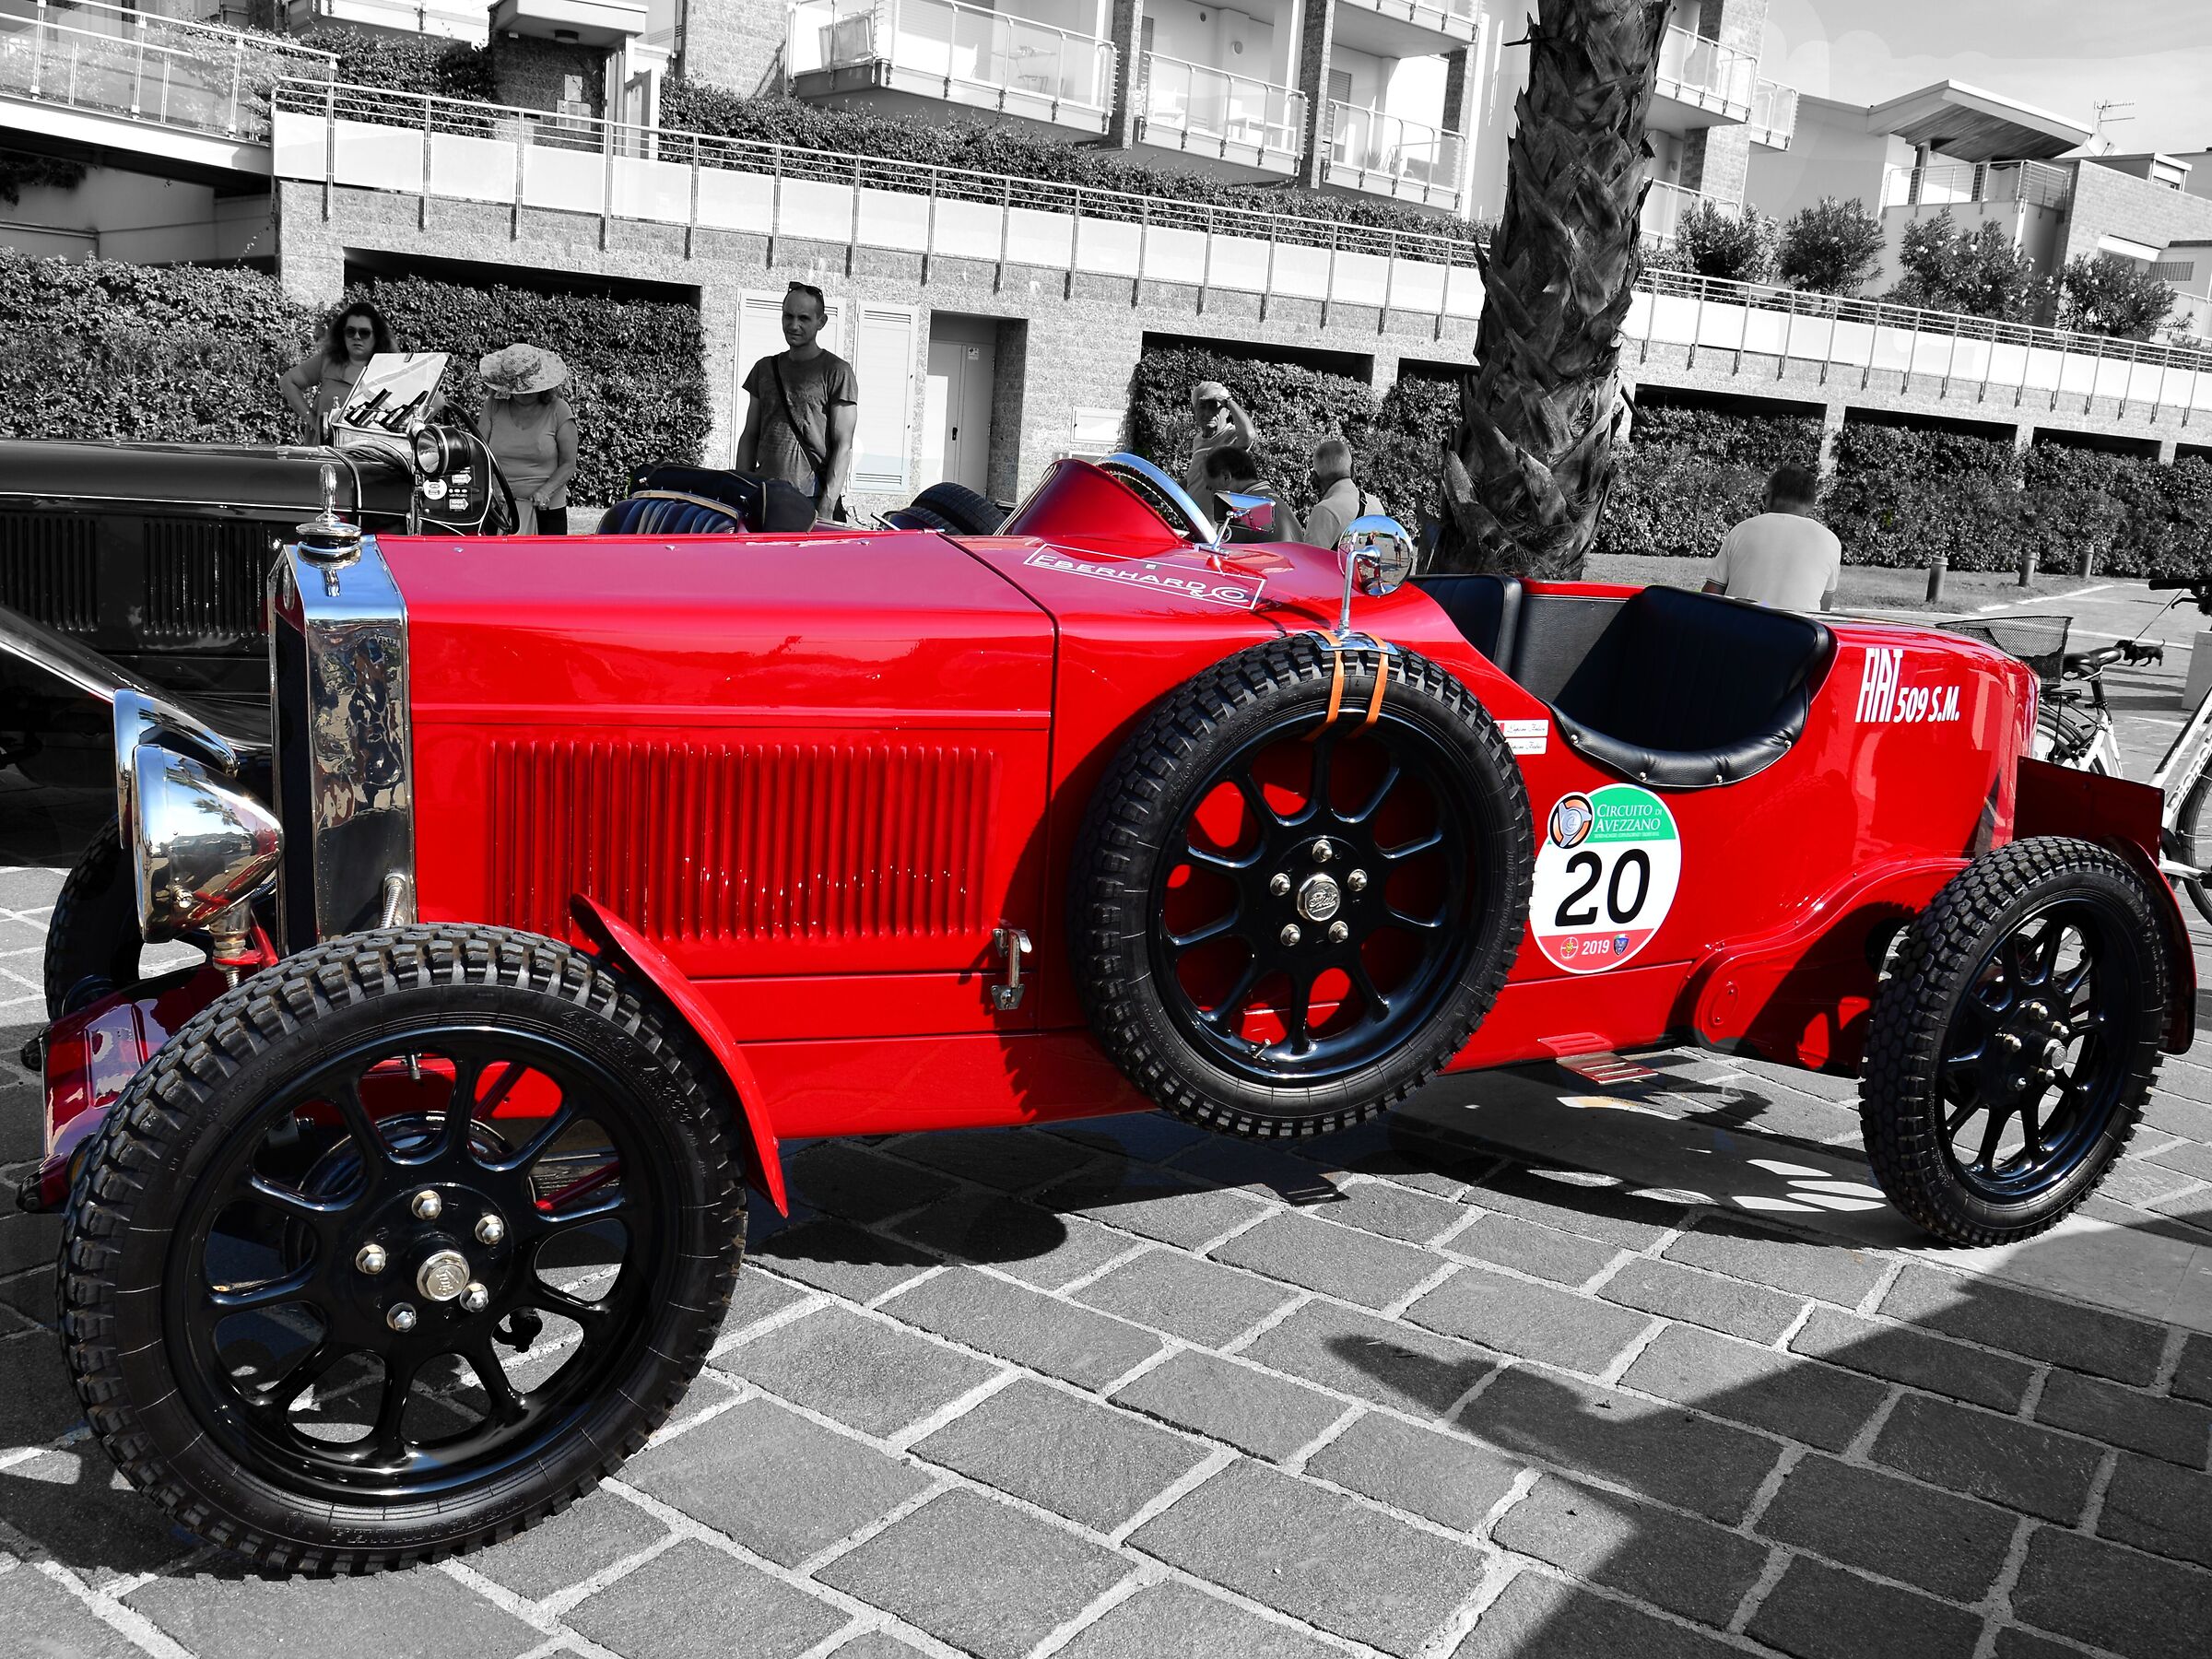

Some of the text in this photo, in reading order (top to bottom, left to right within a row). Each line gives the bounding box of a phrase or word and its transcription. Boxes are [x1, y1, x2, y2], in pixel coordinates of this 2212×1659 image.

[1032, 554, 1207, 591] EBERHARD
[1854, 647, 1960, 724] FIAT 509 S.M.
[1596, 804, 1653, 818] CIRCUITO
[1594, 818, 1662, 833] AVEZZANO
[1554, 848, 1651, 927] 20
[1581, 939, 1610, 956] 2019
